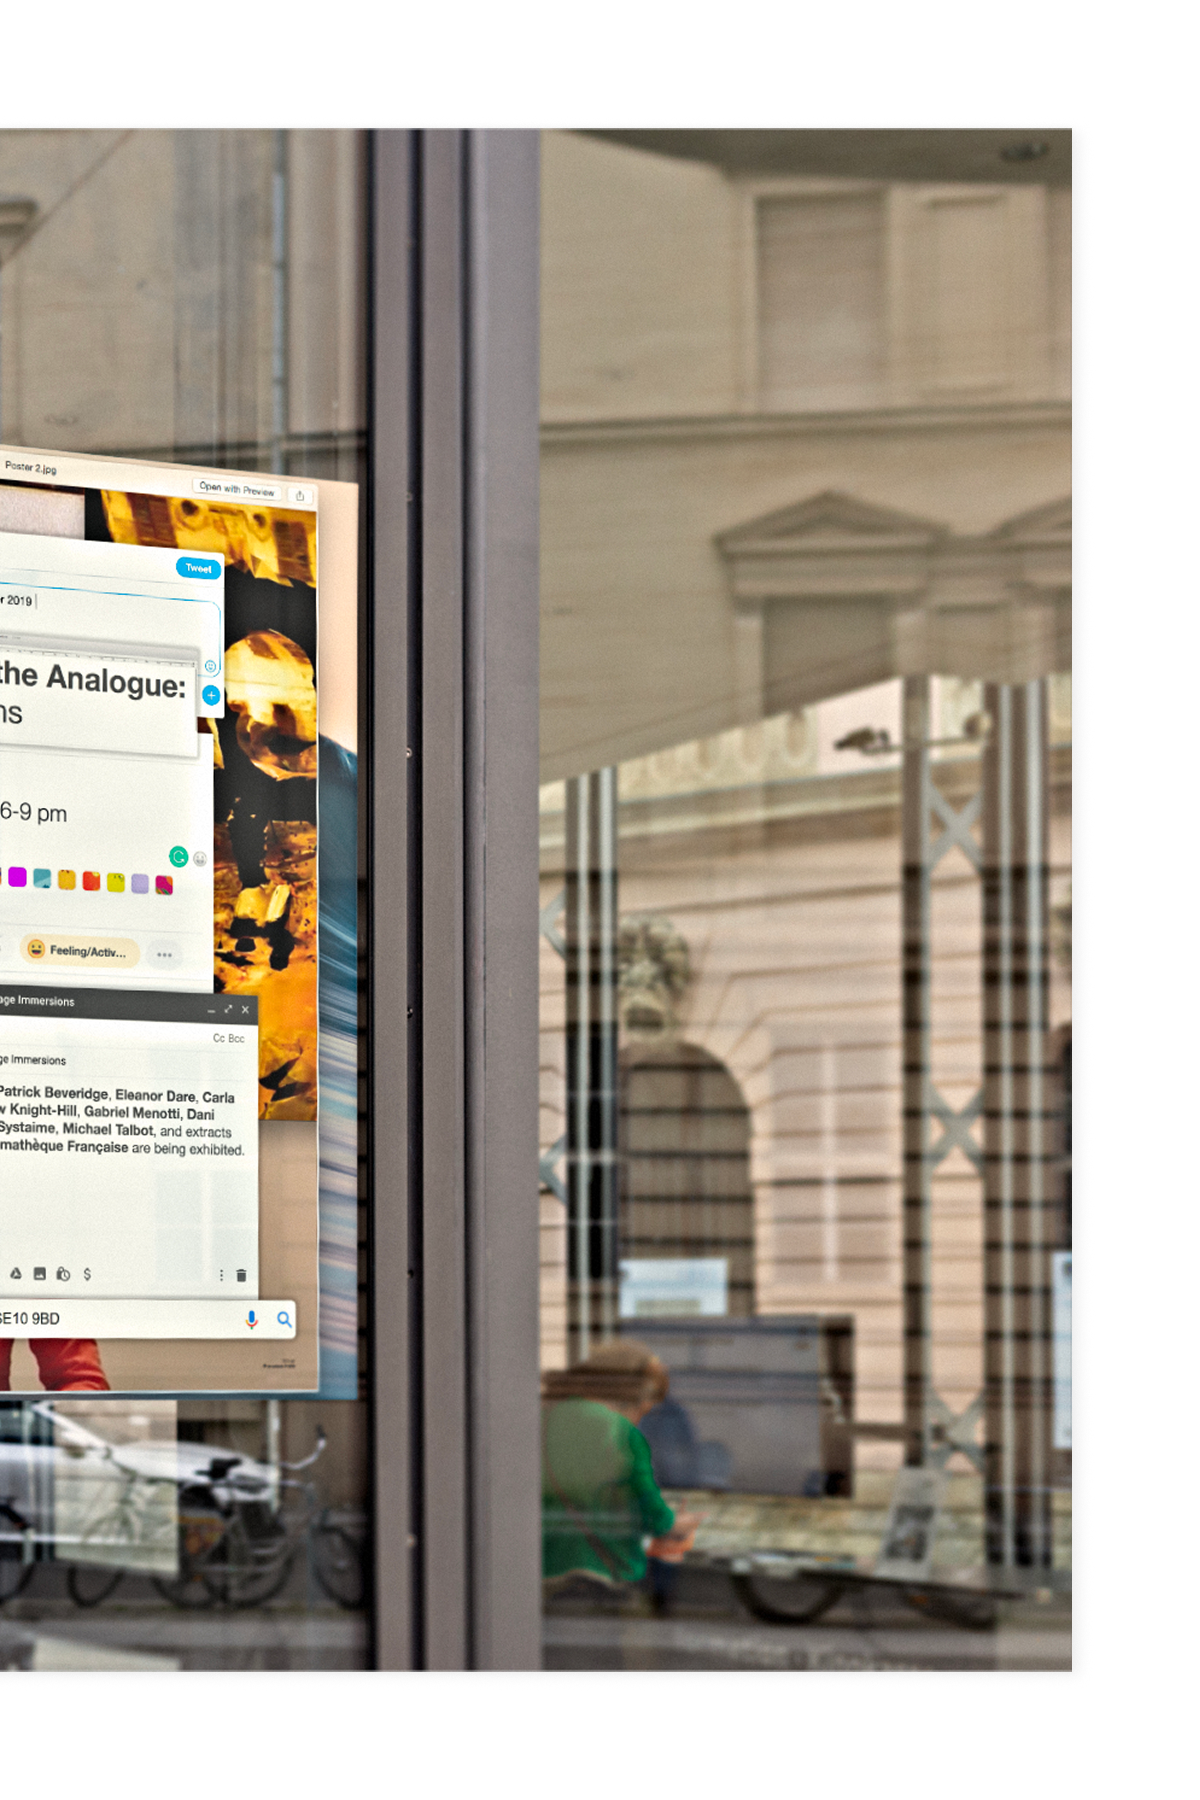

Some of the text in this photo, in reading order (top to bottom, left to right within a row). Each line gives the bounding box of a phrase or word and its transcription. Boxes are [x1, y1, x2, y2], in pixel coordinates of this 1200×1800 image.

[5, 460, 57, 476] Poster 2.jpg
[199, 481, 275, 497] Open with Preview
[185, 563, 212, 574] Tweet
[7, 595, 32, 606] 2019
[46, 664, 186, 700] Analogue:
[0, 801, 32, 821] 6-9
[37, 806, 68, 825] pm
[18, 994, 75, 1007] Immersions
[213, 1033, 225, 1043] Cc
[228, 1034, 245, 1044] Bcc
[11, 1054, 66, 1066] Immersions
[45, 1086, 112, 1102] Beveridge,
[115, 1089, 163, 1102] Eleanor
[167, 1090, 199, 1105] Dare,
[202, 1091, 235, 1104] Carla
[10, 1103, 81, 1119] Knight-Hill,
[84, 1105, 129, 1118] Gabriel
[133, 1107, 183, 1121] Menotti,
[187, 1108, 215, 1121] Dani
[63, 1122, 111, 1136] Michael
[115, 1124, 156, 1138] Talbot,
[160, 1125, 182, 1137] and
[185, 1127, 232, 1138] extracts
[67, 1140, 128, 1155] Française
[132, 1143, 151, 1153] are
[154, 1142, 186, 1157] being
[189, 1143, 245, 1157] exhibited.
[32, 1312, 60, 1325] 9BD
